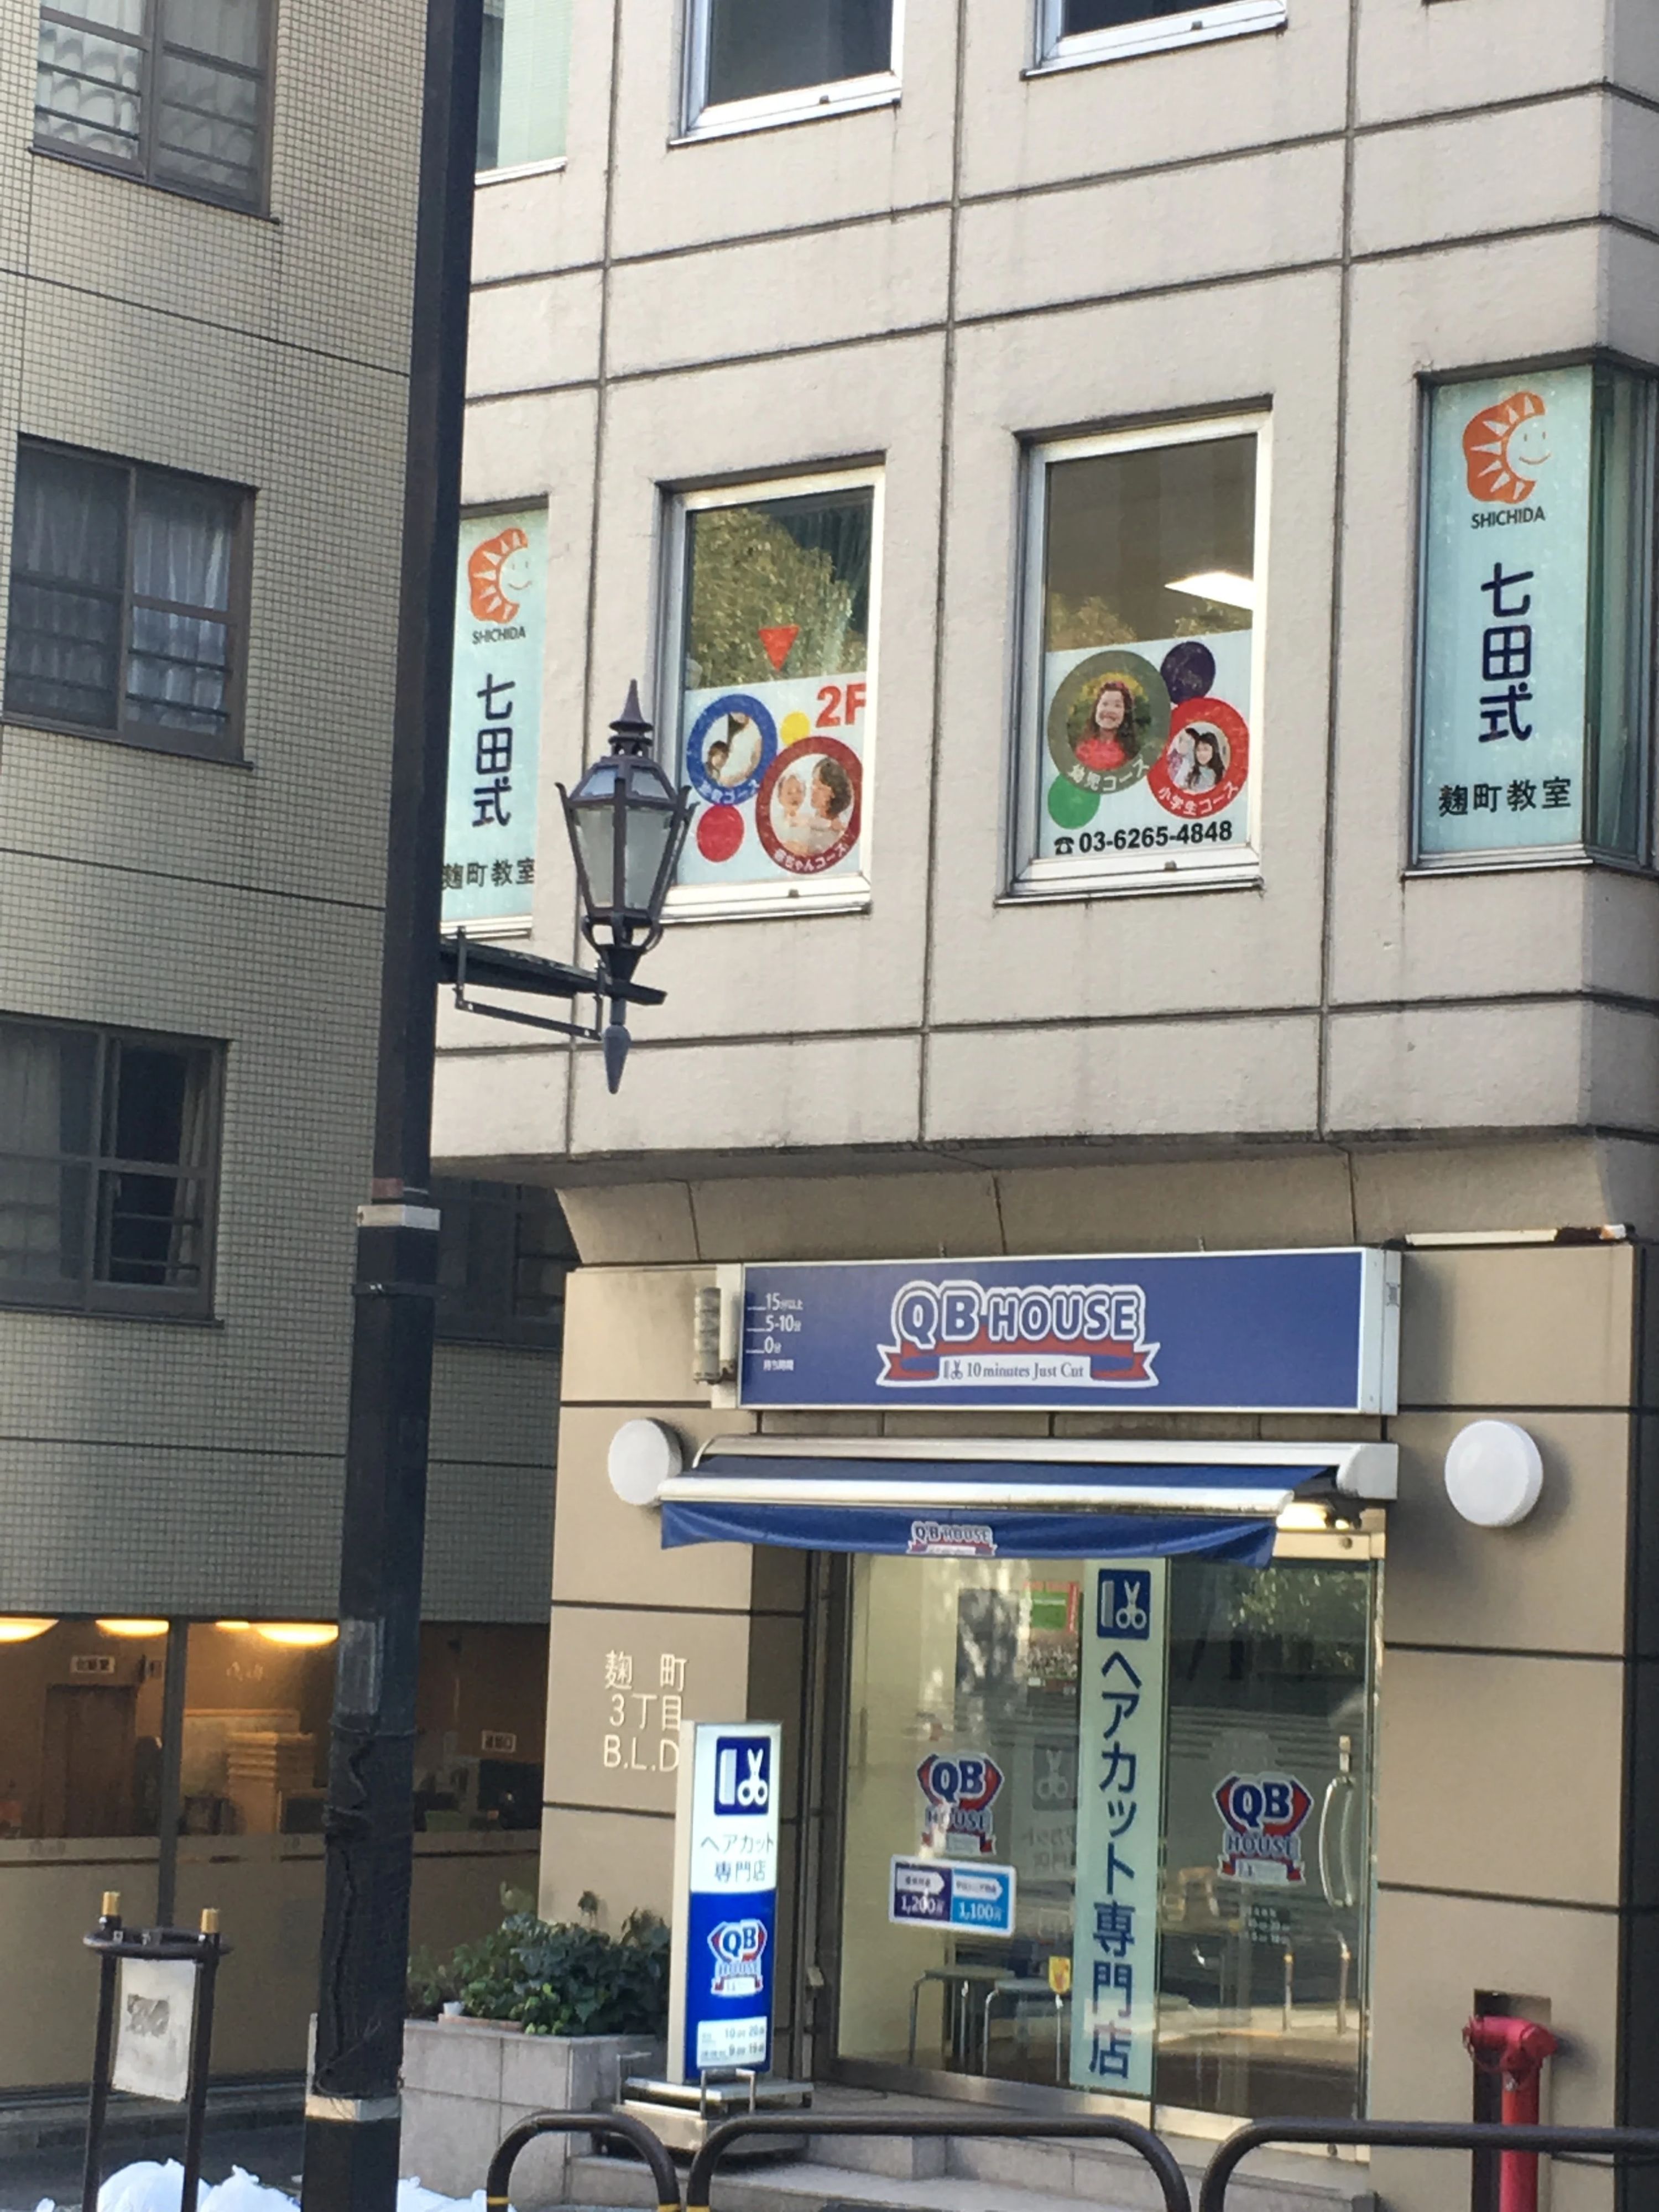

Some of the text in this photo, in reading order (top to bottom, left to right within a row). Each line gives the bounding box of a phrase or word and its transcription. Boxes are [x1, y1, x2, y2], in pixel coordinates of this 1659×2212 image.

[1470, 507, 1546, 529] SHICHIDA
[472, 625, 526, 644] SHICHIDA
[1479, 562, 1534, 743] 七田式
[815, 682, 866, 728] 2F
[472, 673, 516, 826] 七田式
[1159, 780, 1238, 816] 小学生コース
[1438, 776, 1572, 817] 麹町教室
[1079, 821, 1233, 853] 03-6265-4848
[442, 857, 535, 891] 麹町教室
[899, 1291, 1138, 1349] QB HOUSE
[967, 1361, 1084, 1380] 10 minutes Just Cut
[915, 1526, 989, 1543] QB HOUSE
[609, 1693, 681, 1731] 3丁目
[932, 1760, 983, 1803] QB
[927, 1807, 988, 1829] HUSE
[1232, 1782, 1290, 1828] QB
[700, 1832, 774, 1855] ヘアカット
[1228, 1834, 1296, 1856] HOUSE
[714, 1860, 766, 1883] 専門店
[1089, 1650, 1142, 2080] ヘアカット専門店
[722, 1927, 757, 1958] QB
